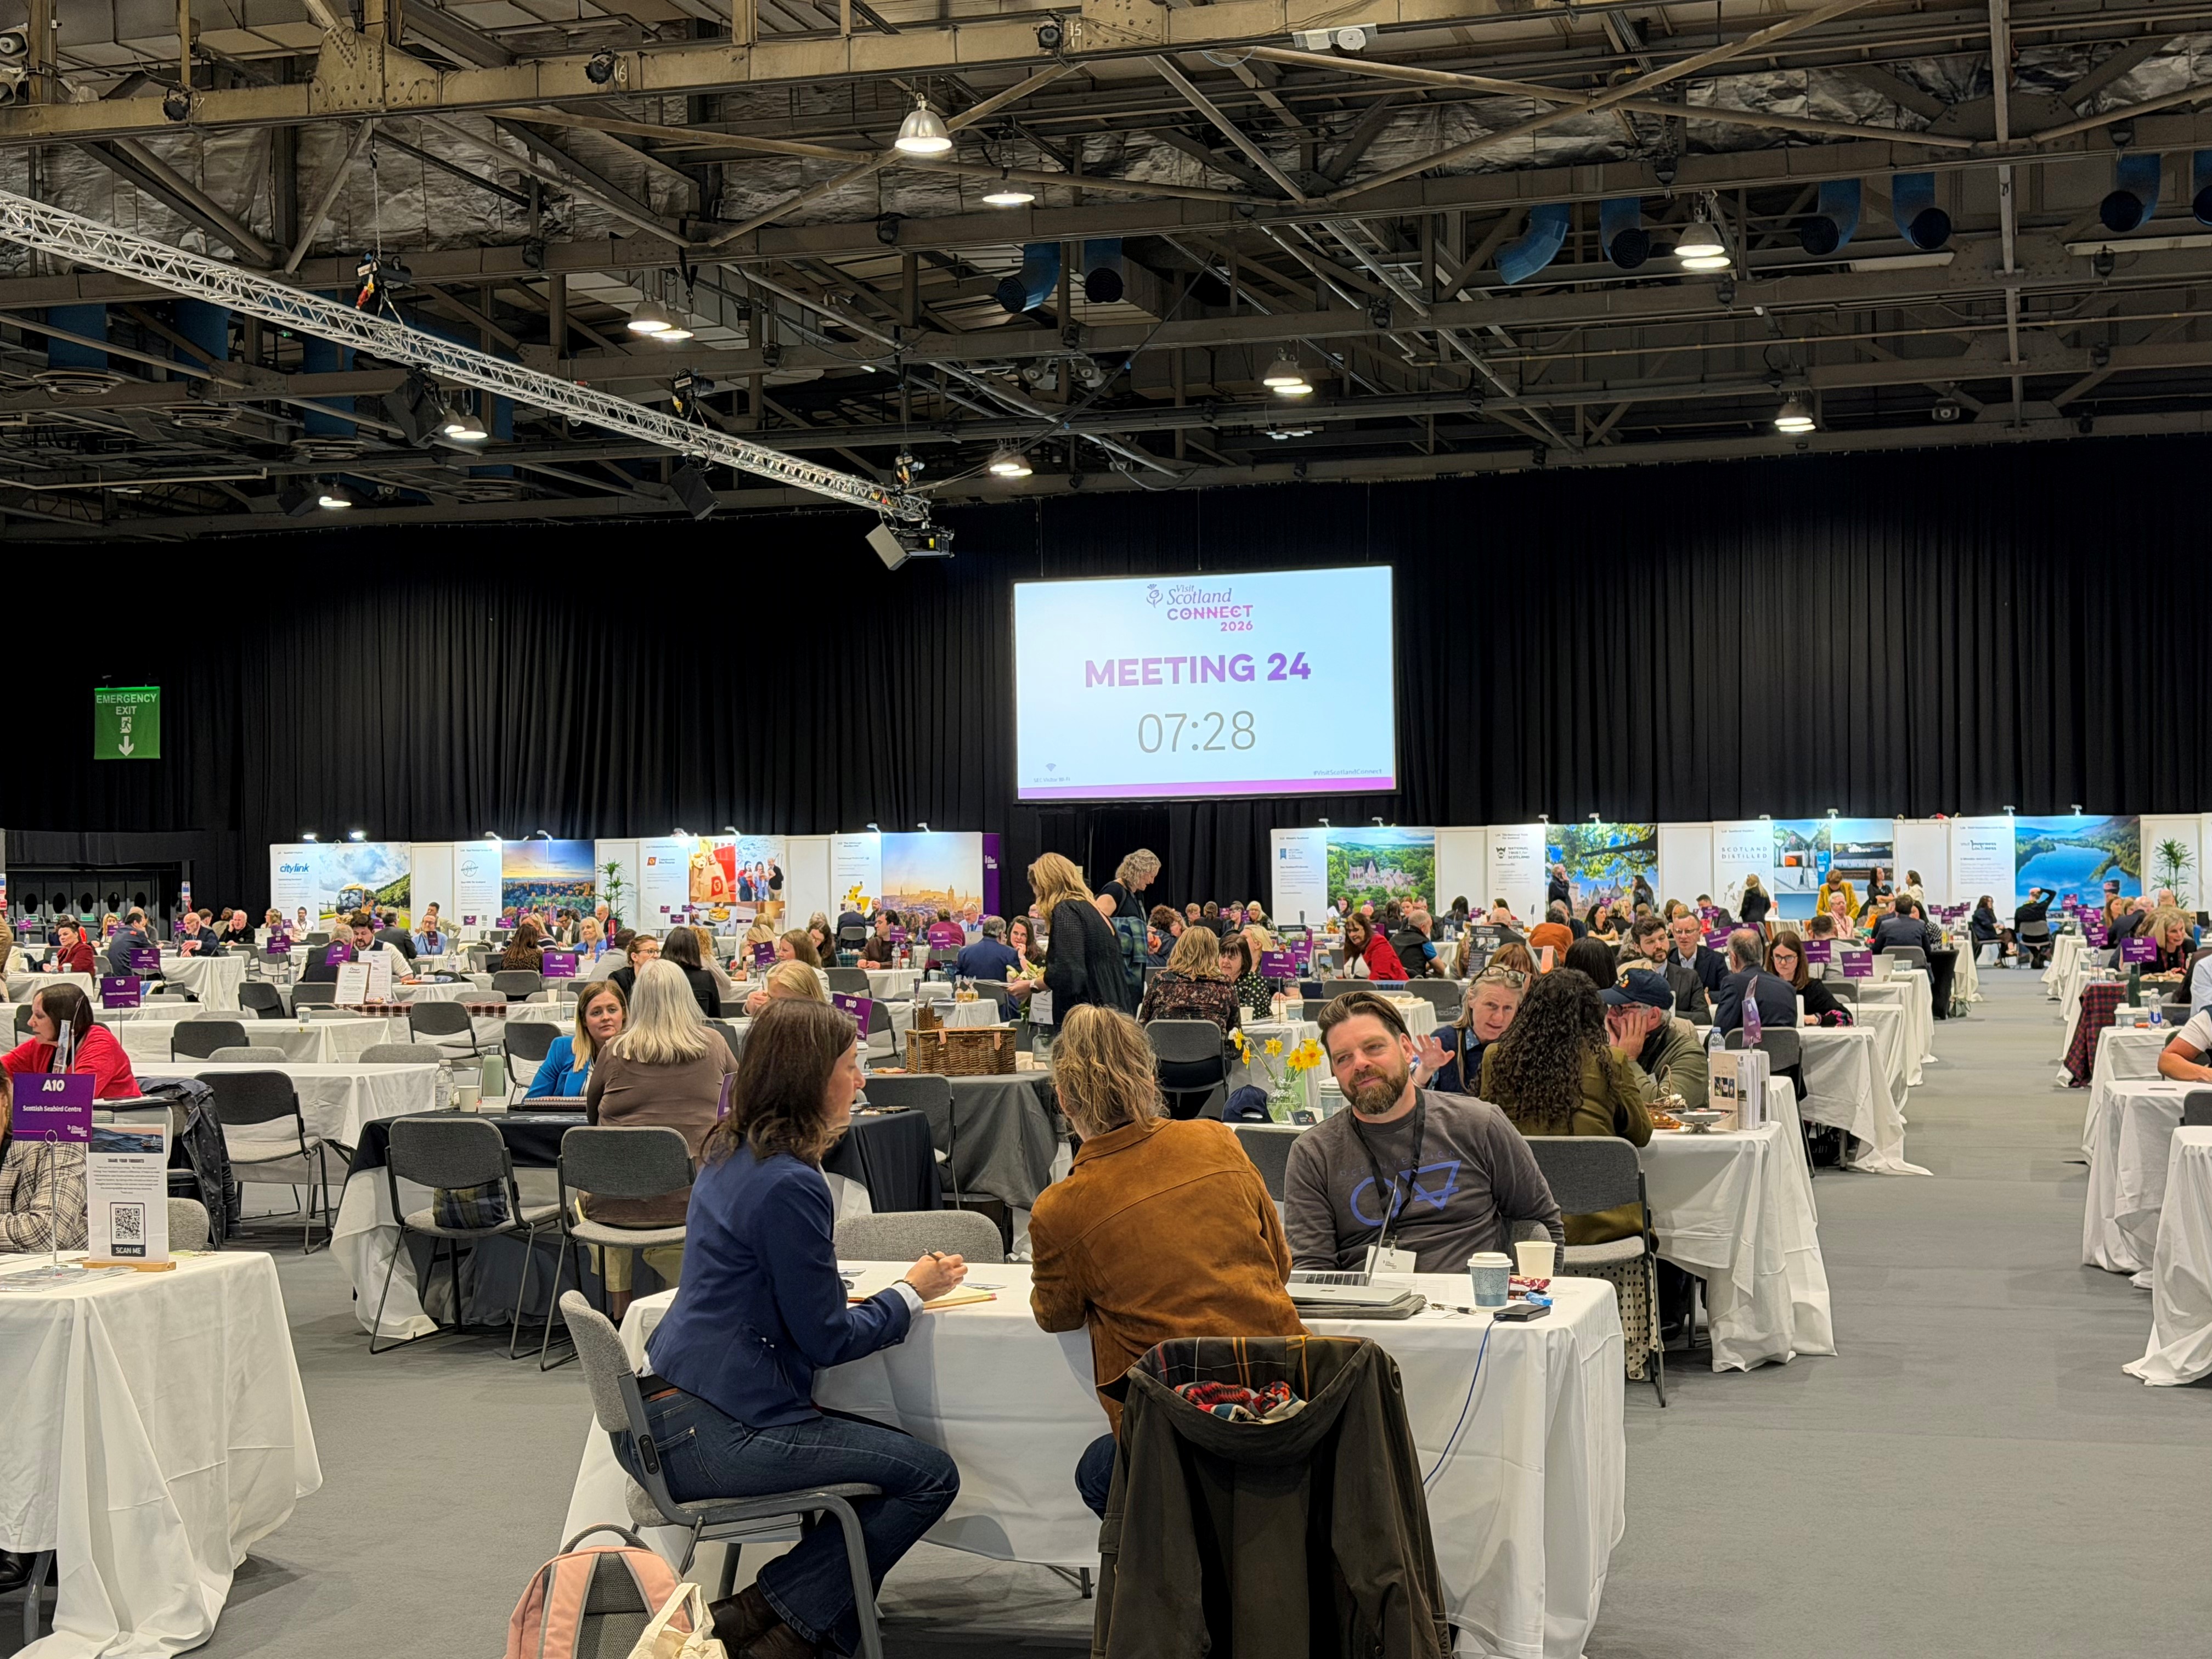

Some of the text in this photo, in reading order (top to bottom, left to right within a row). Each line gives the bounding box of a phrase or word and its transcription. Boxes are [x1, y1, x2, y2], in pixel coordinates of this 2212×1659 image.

[1176, 584, 1195, 593] Visit
[1167, 588, 1232, 605] Scotland
[1167, 605, 1254, 620] CONNECT
[1220, 620, 1254, 632] 2026
[1085, 652, 1311, 688] MEETING 24
[97, 693, 157, 704] EMERGENCY
[116, 706, 137, 715] EXIT
[1137, 710, 1256, 753] 07:28
[280, 863, 310, 873] citylink
[845, 999, 857, 1008] B10
[42, 1079, 65, 1092] A10
